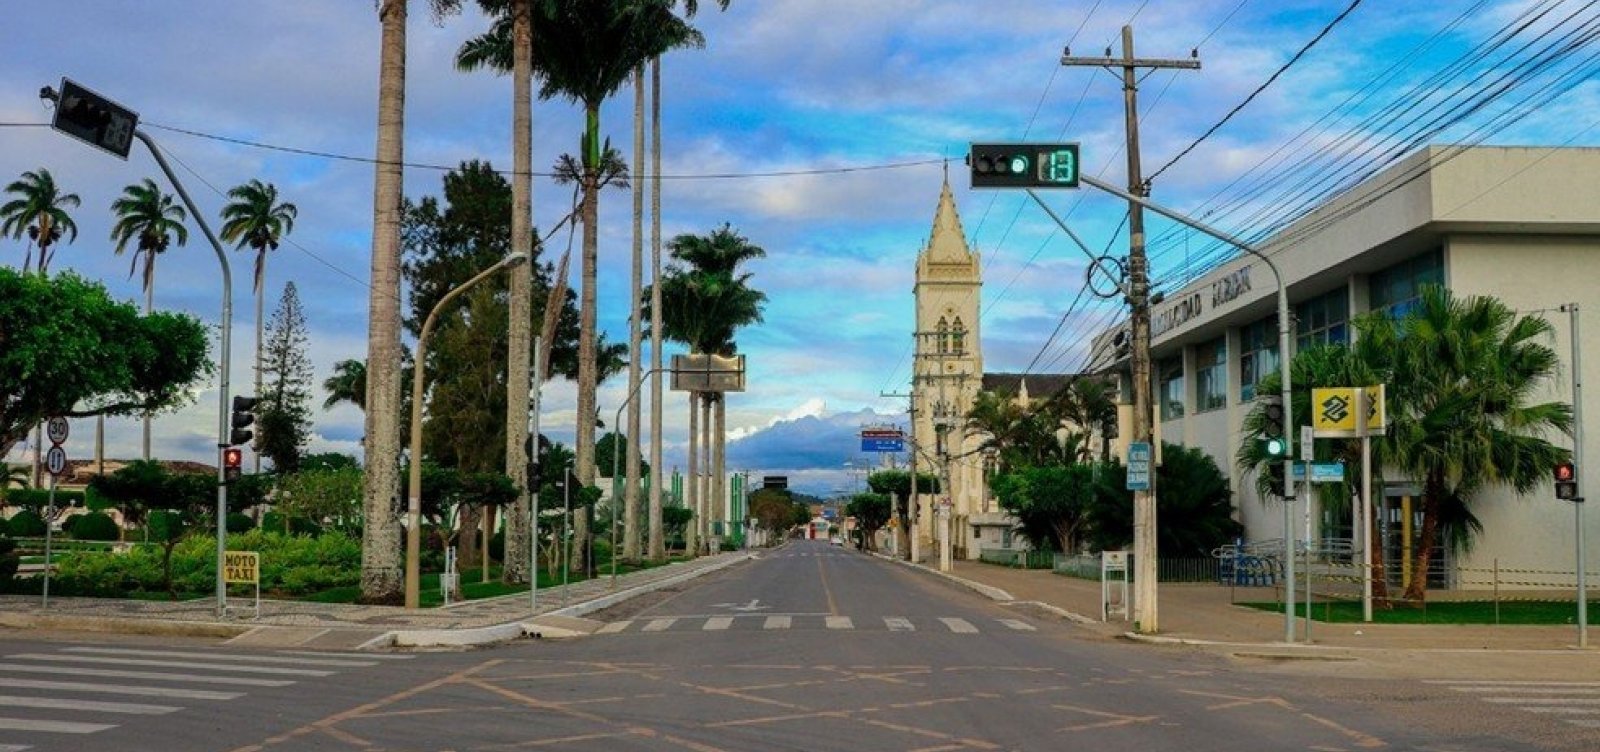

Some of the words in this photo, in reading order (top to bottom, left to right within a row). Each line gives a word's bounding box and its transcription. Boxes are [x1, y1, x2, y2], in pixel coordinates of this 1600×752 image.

[1050, 151, 1074, 182] 13
[51, 421, 65, 435] 30
[225, 554, 255, 567] MOTO
[225, 568, 254, 580] TAXI
